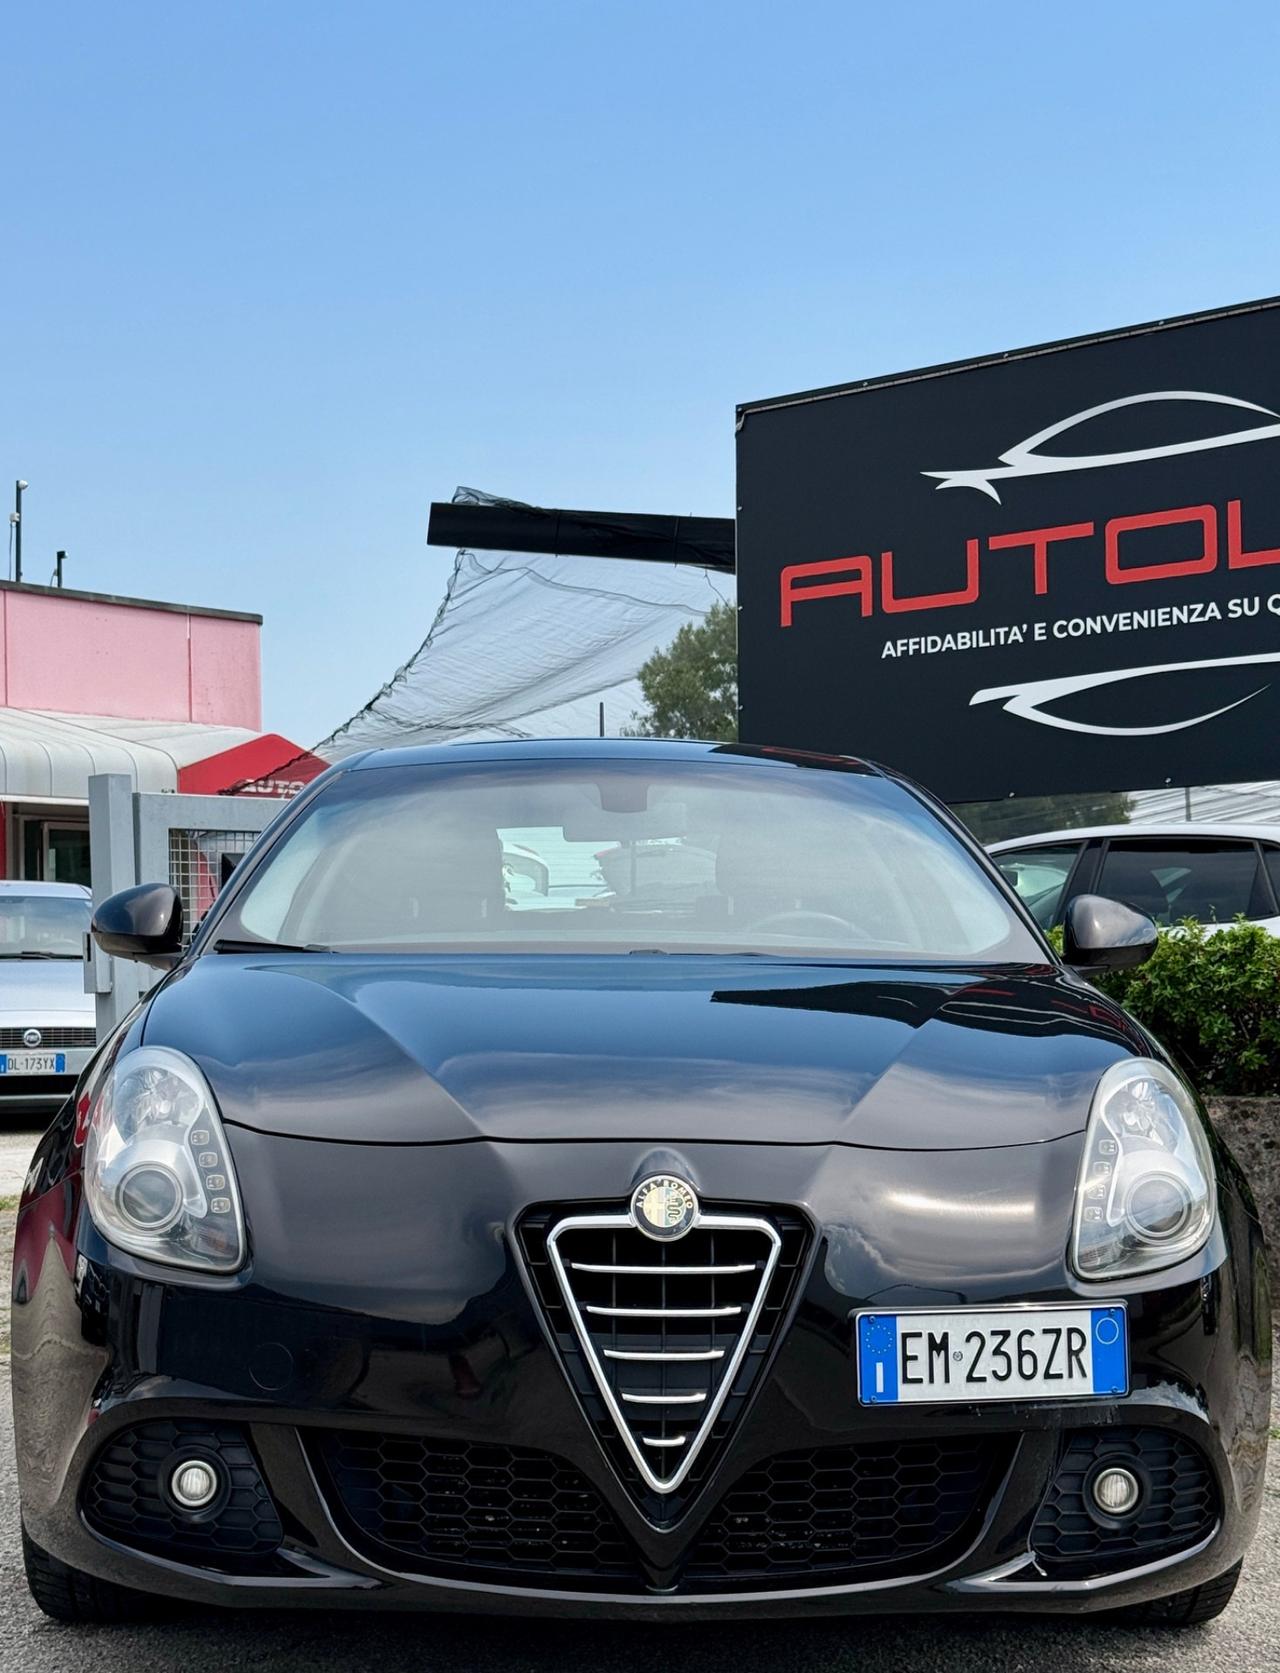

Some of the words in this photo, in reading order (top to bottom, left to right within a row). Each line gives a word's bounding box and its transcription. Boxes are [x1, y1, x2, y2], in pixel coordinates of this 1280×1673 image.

[1033, 622, 1047, 641] E
[1052, 601, 1222, 639] CONVENIENZA
[1227, 596, 1260, 618] SU
